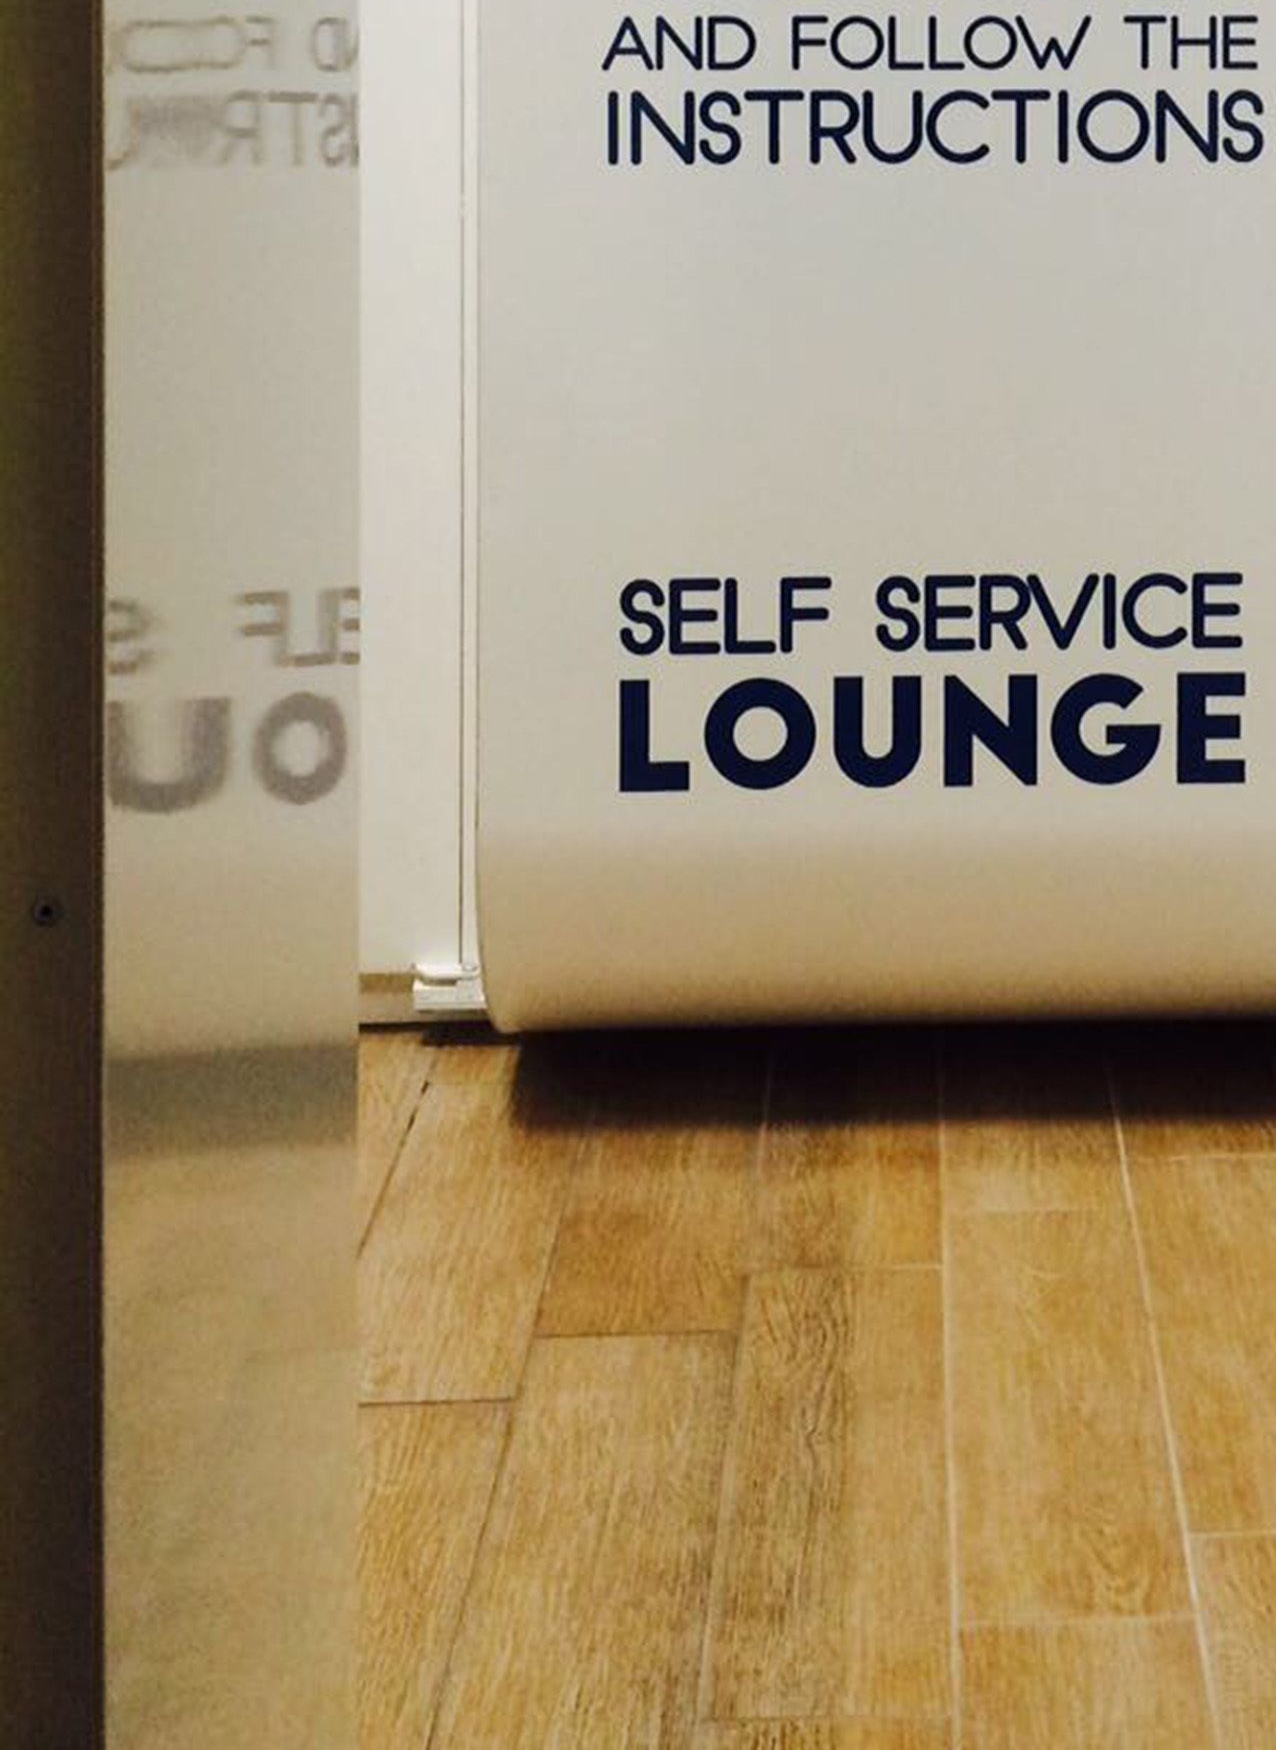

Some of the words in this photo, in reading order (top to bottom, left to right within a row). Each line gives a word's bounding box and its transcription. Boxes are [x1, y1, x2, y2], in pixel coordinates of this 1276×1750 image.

[601, 15, 757, 71] AND
[791, 15, 1092, 71] FOLLOW
[1123, 15, 1259, 70] THE
[607, 89, 1264, 166] INSTRUCTIONS
[619, 576, 833, 657] SELF
[875, 572, 1244, 653] SERVICE
[618, 671, 1247, 793] LOUNGE
